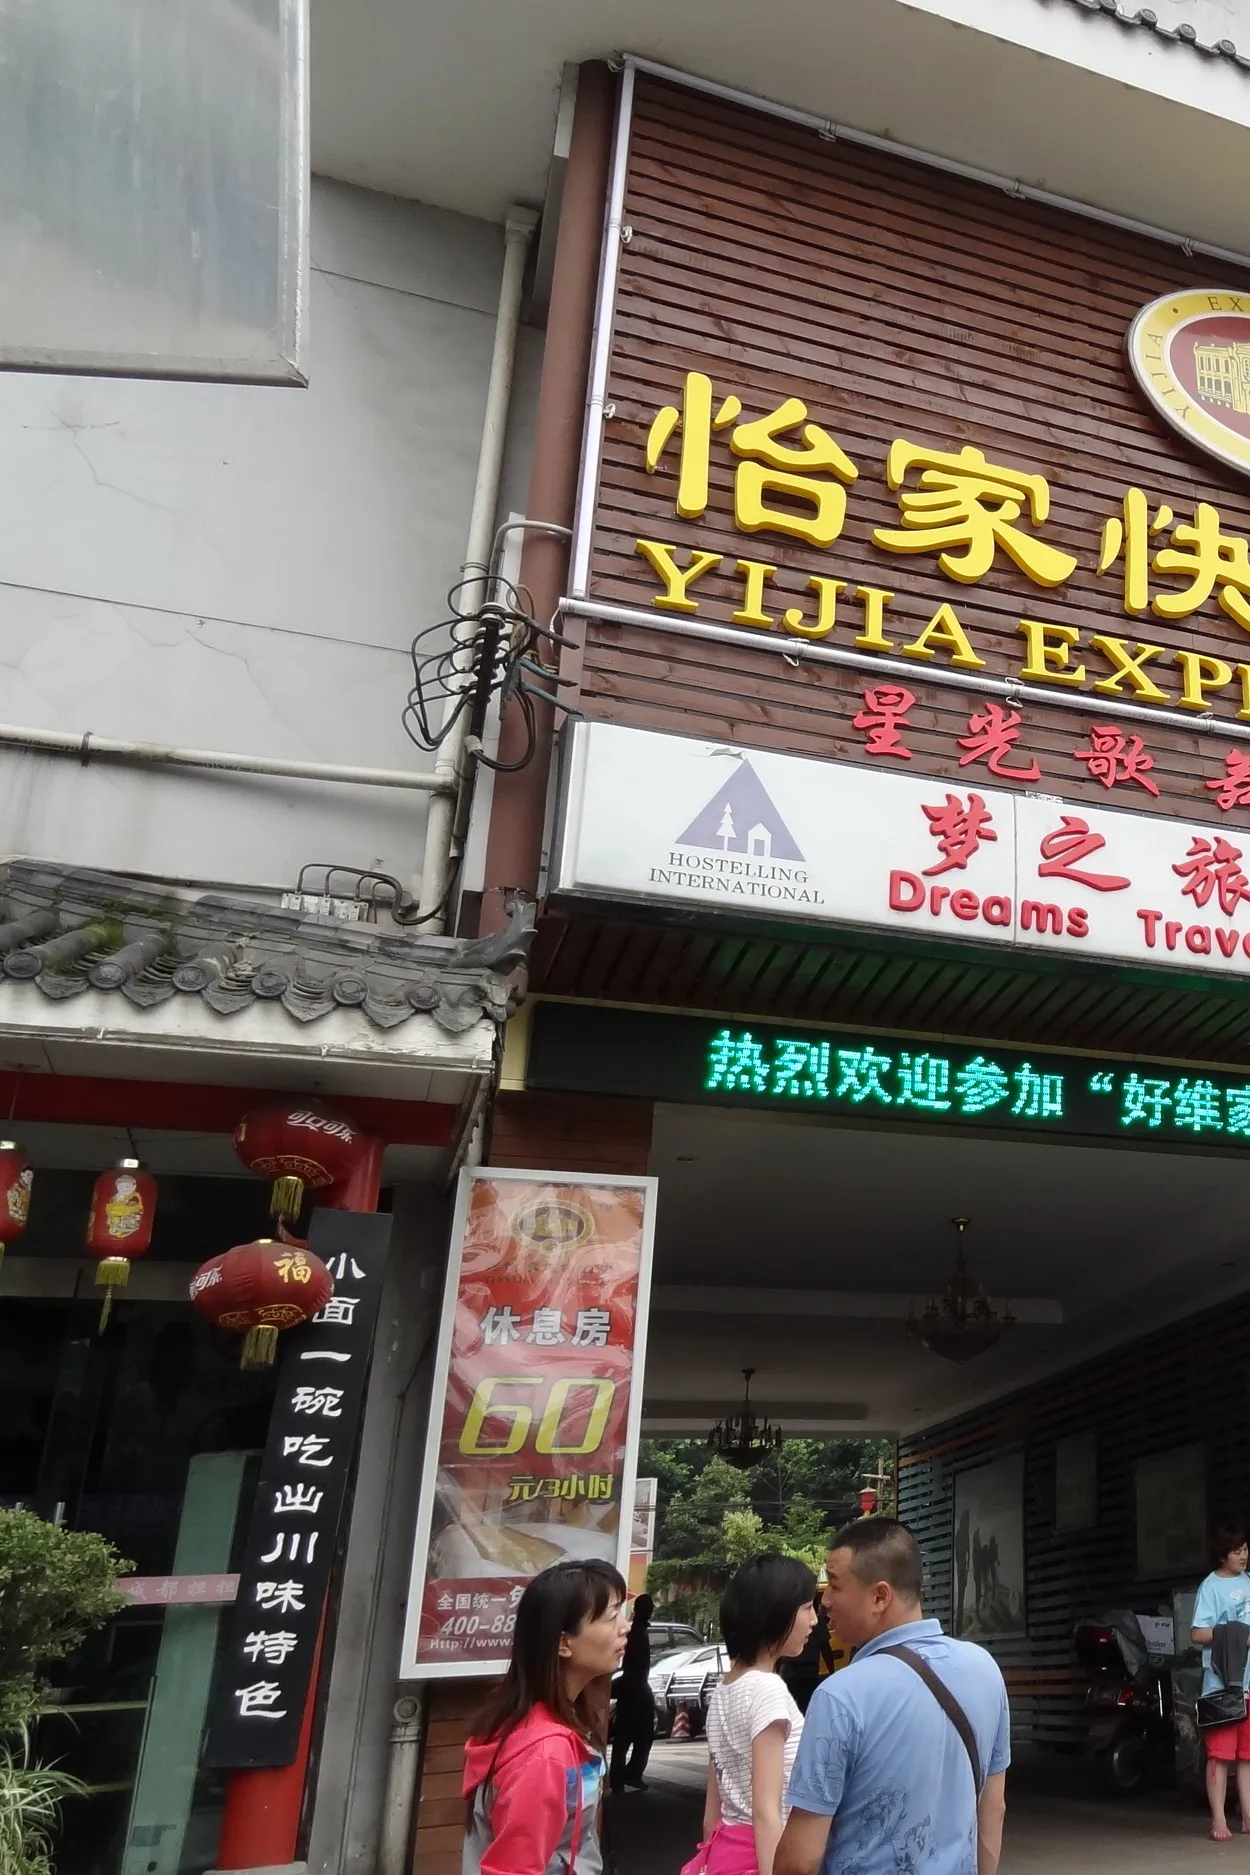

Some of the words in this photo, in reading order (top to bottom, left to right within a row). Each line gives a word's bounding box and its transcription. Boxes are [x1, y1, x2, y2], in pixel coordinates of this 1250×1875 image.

[1146, 331, 1192, 419] YIJIA
[635, 539, 986, 670] YIJIA
[649, 867, 825, 905] INTERNATIONAL
[668, 851, 809, 884] HOSTELLING
[889, 869, 1089, 938] Dreams
[286, 1110, 357, 1145] 可口可乐
[274, 1252, 312, 1284] 福
[480, 1304, 612, 1347] 休息房
[458, 1376, 616, 1456] 60
[507, 1473, 615, 1502] 元/3小时
